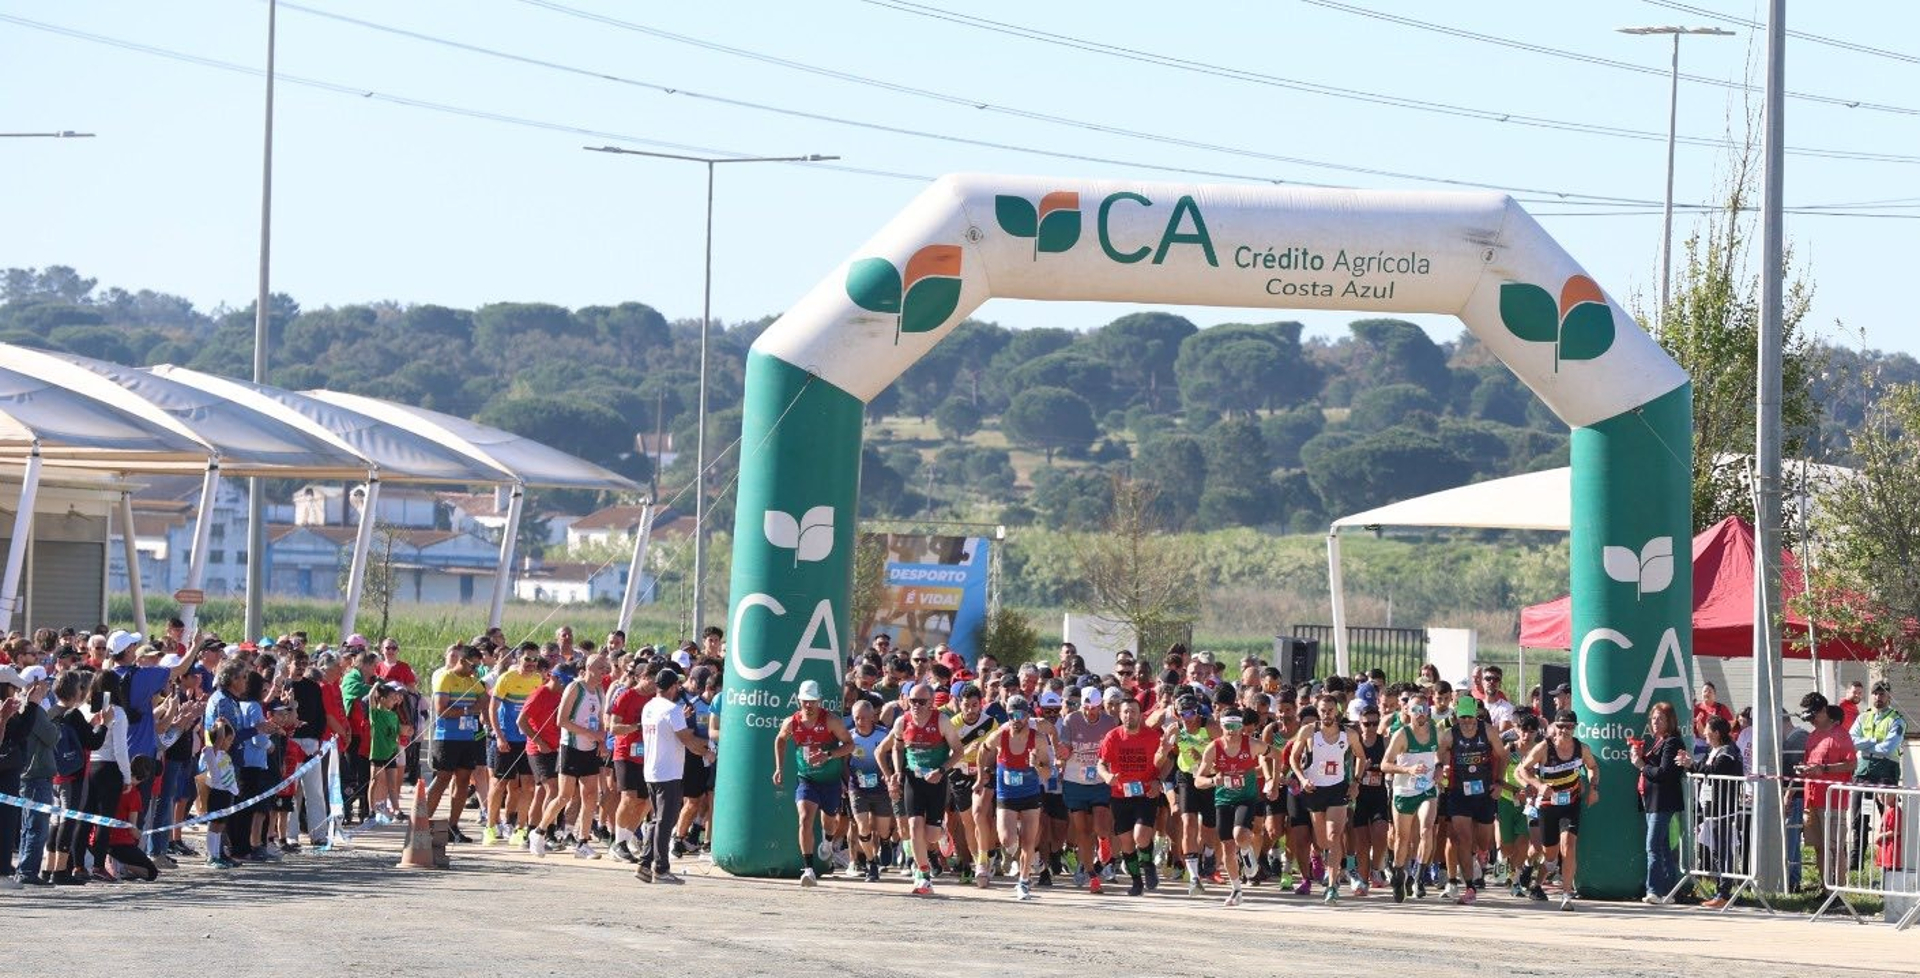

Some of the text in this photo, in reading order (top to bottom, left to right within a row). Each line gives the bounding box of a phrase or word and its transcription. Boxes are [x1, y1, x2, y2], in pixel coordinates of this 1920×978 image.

[1097, 191, 1219, 268] CA
[1234, 245, 1431, 277] Crédito Agrícola
[1265, 278, 1395, 299] Costa Azul
[889, 568, 967, 582] DESPORTO
[905, 589, 960, 606] É VIDA!
[731, 592, 843, 687] CA
[1578, 627, 1692, 715] CA
[726, 687, 780, 707] Crédito
[1577, 721, 1634, 740] Crédito
